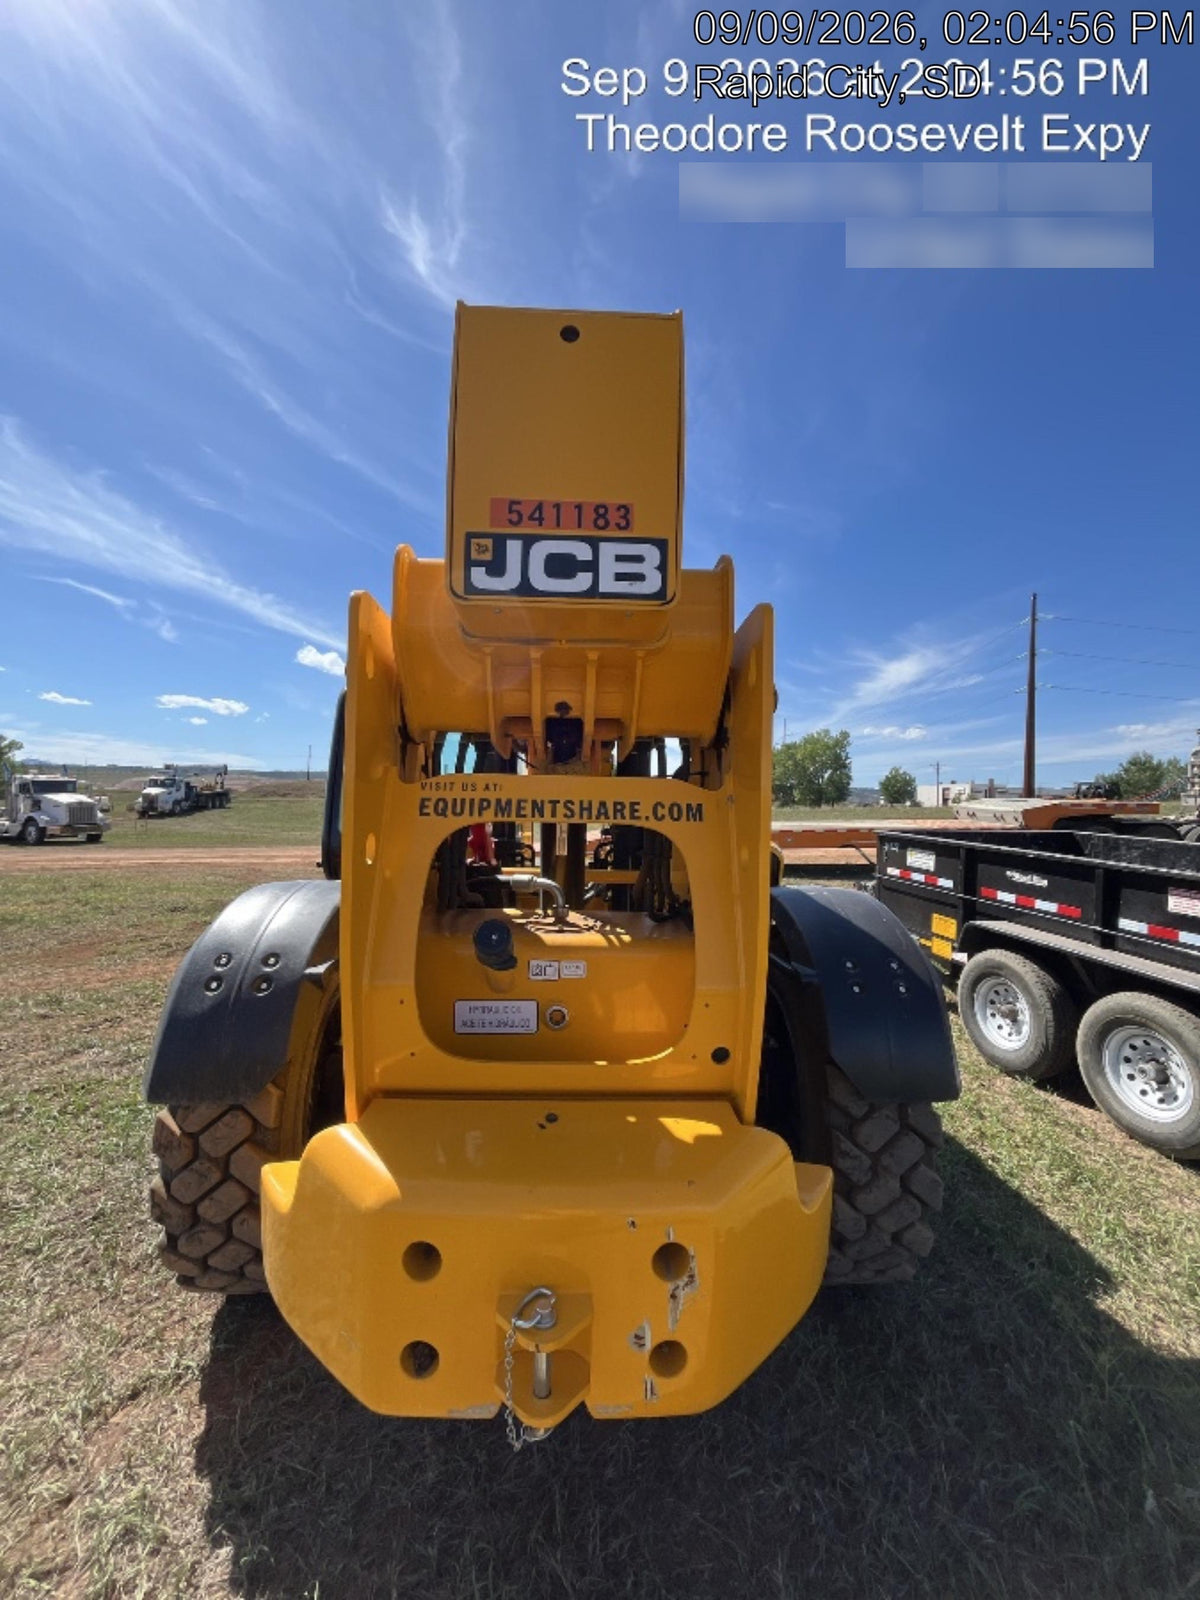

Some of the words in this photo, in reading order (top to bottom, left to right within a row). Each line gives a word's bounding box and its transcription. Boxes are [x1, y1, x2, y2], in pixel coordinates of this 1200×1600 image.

[507, 500, 632, 531] 541183
[470, 539, 663, 595] JCB
[420, 781, 456, 791] VISIT
[461, 783, 478, 792] US
[418, 797, 704, 822] EQUIPMENTSHARE.COM
